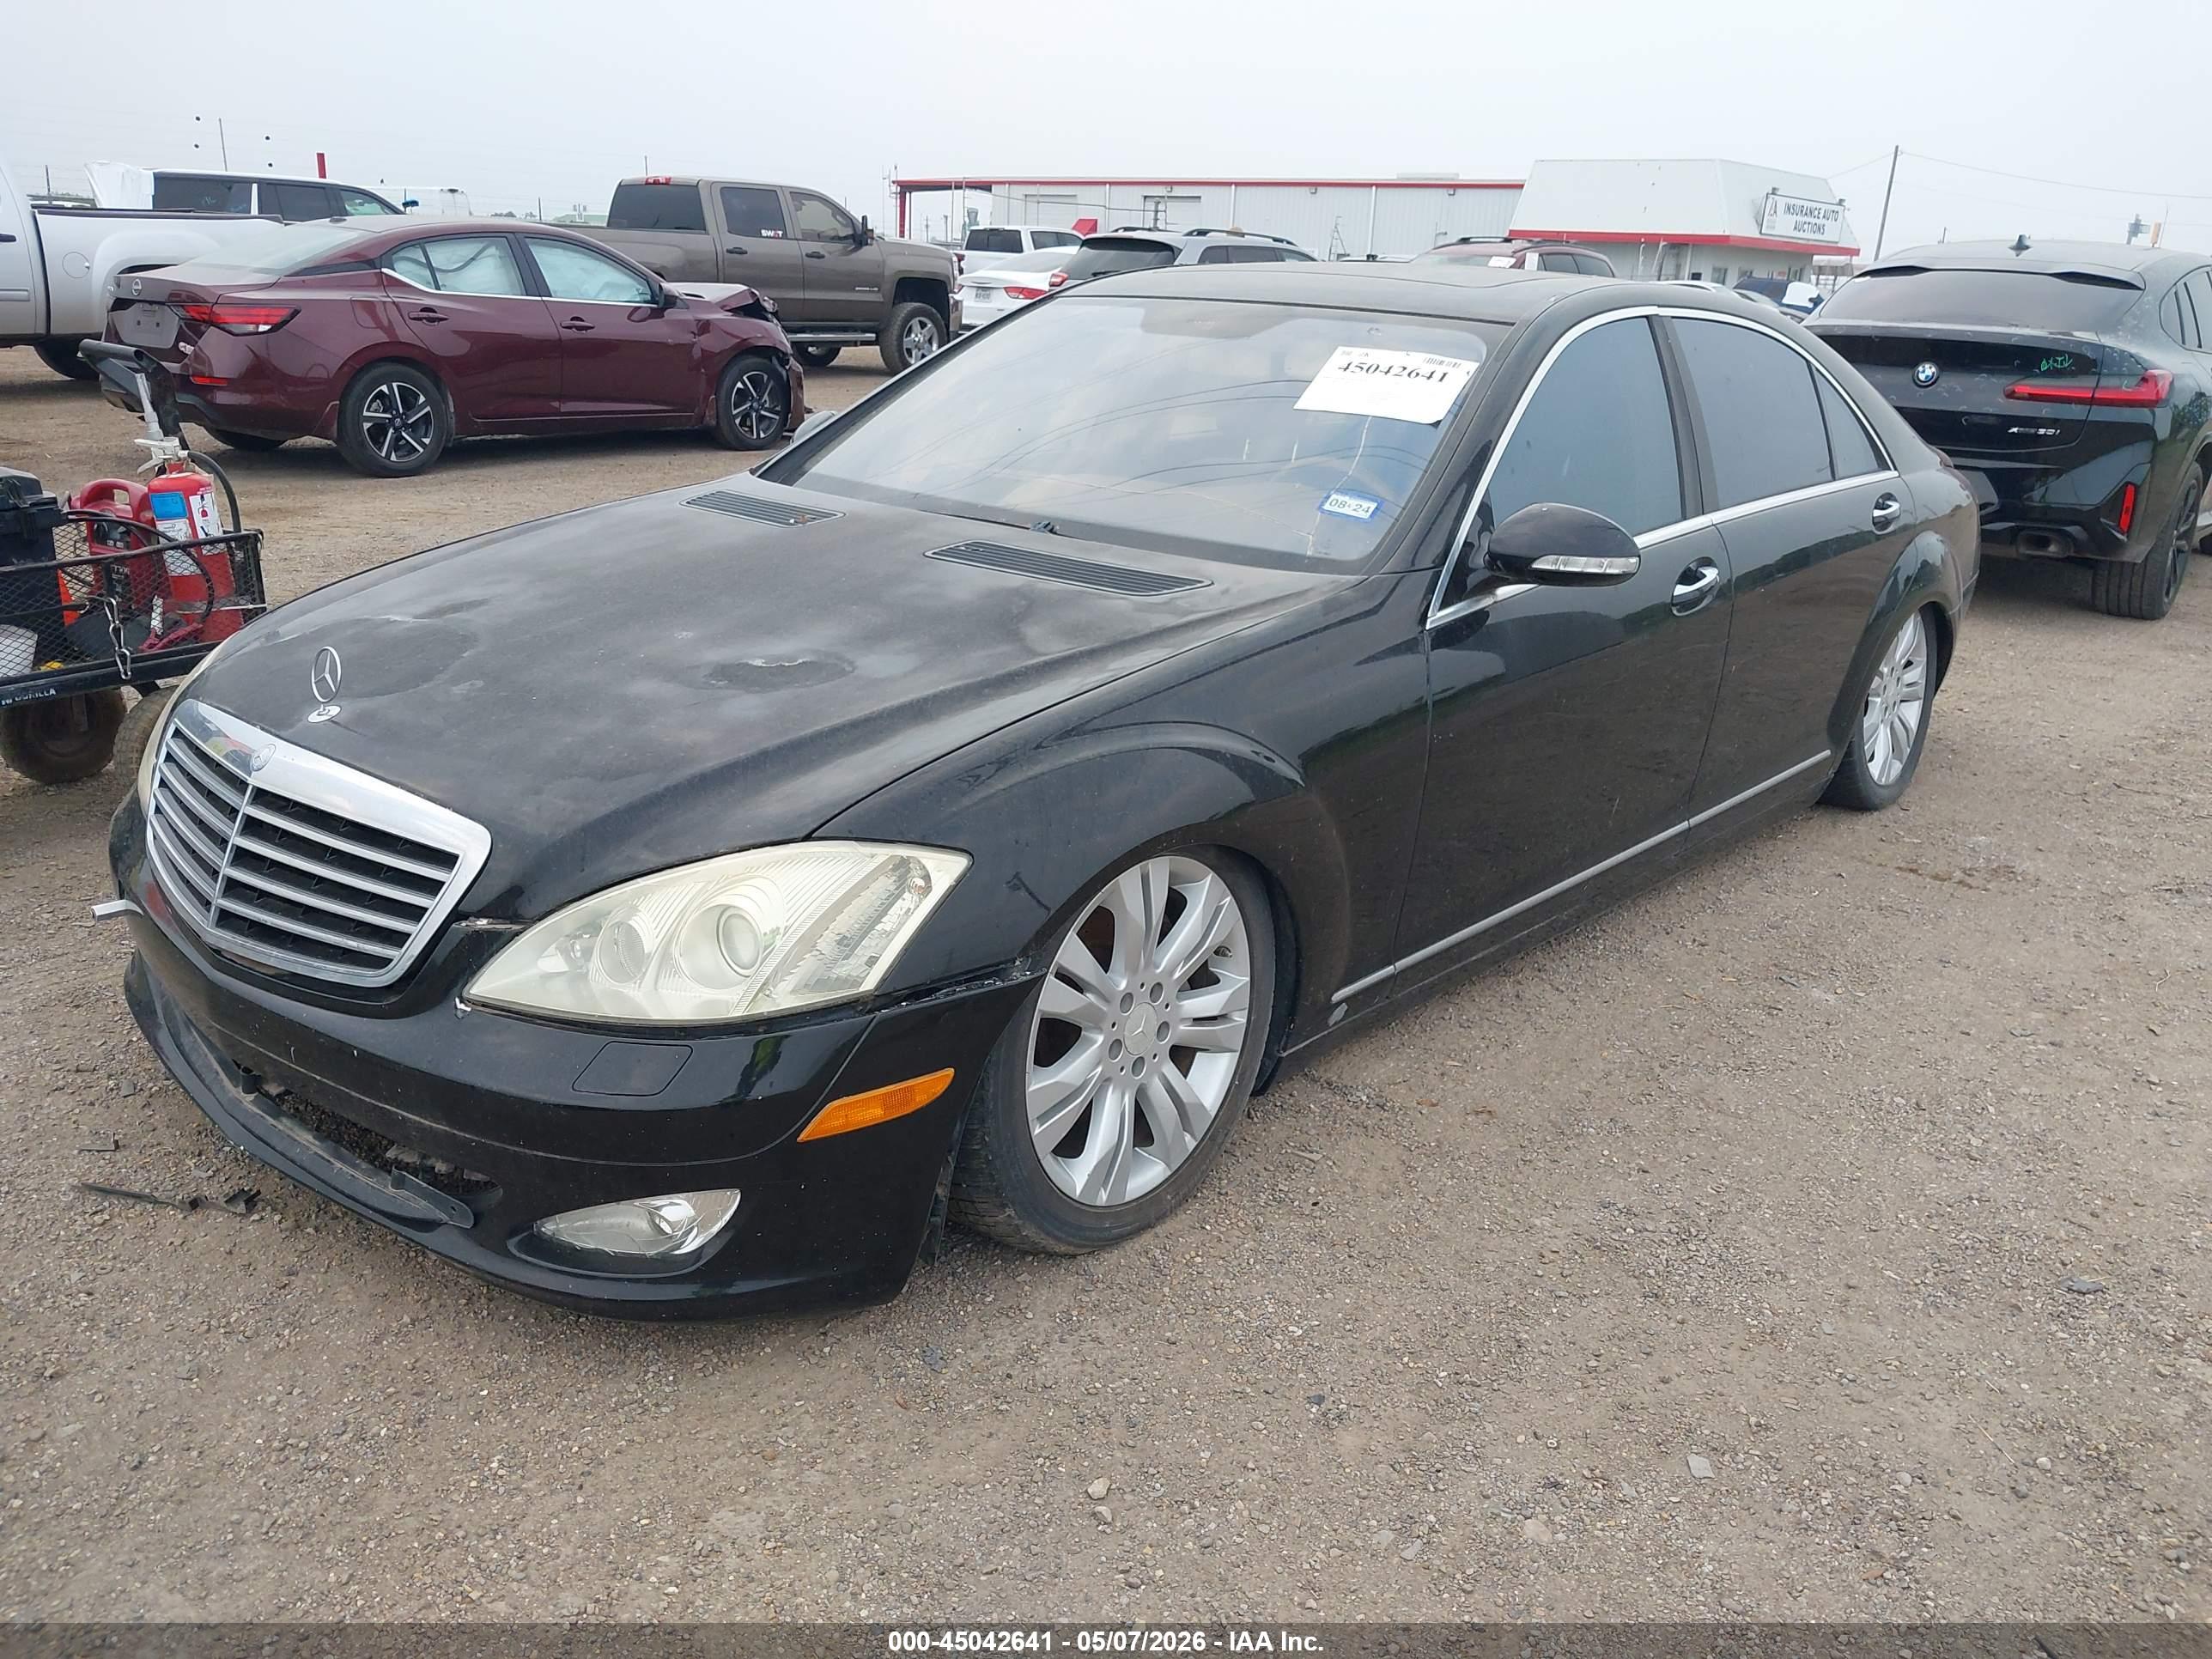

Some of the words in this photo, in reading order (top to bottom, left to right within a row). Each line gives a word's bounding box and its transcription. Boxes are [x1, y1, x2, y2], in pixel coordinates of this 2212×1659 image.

[1784, 202, 1820, 220] INSURANCE
[1821, 209, 1839, 222] AUTO
[1793, 219, 1826, 235] AUCTIONS
[1338, 361, 1449, 383] 45042641
